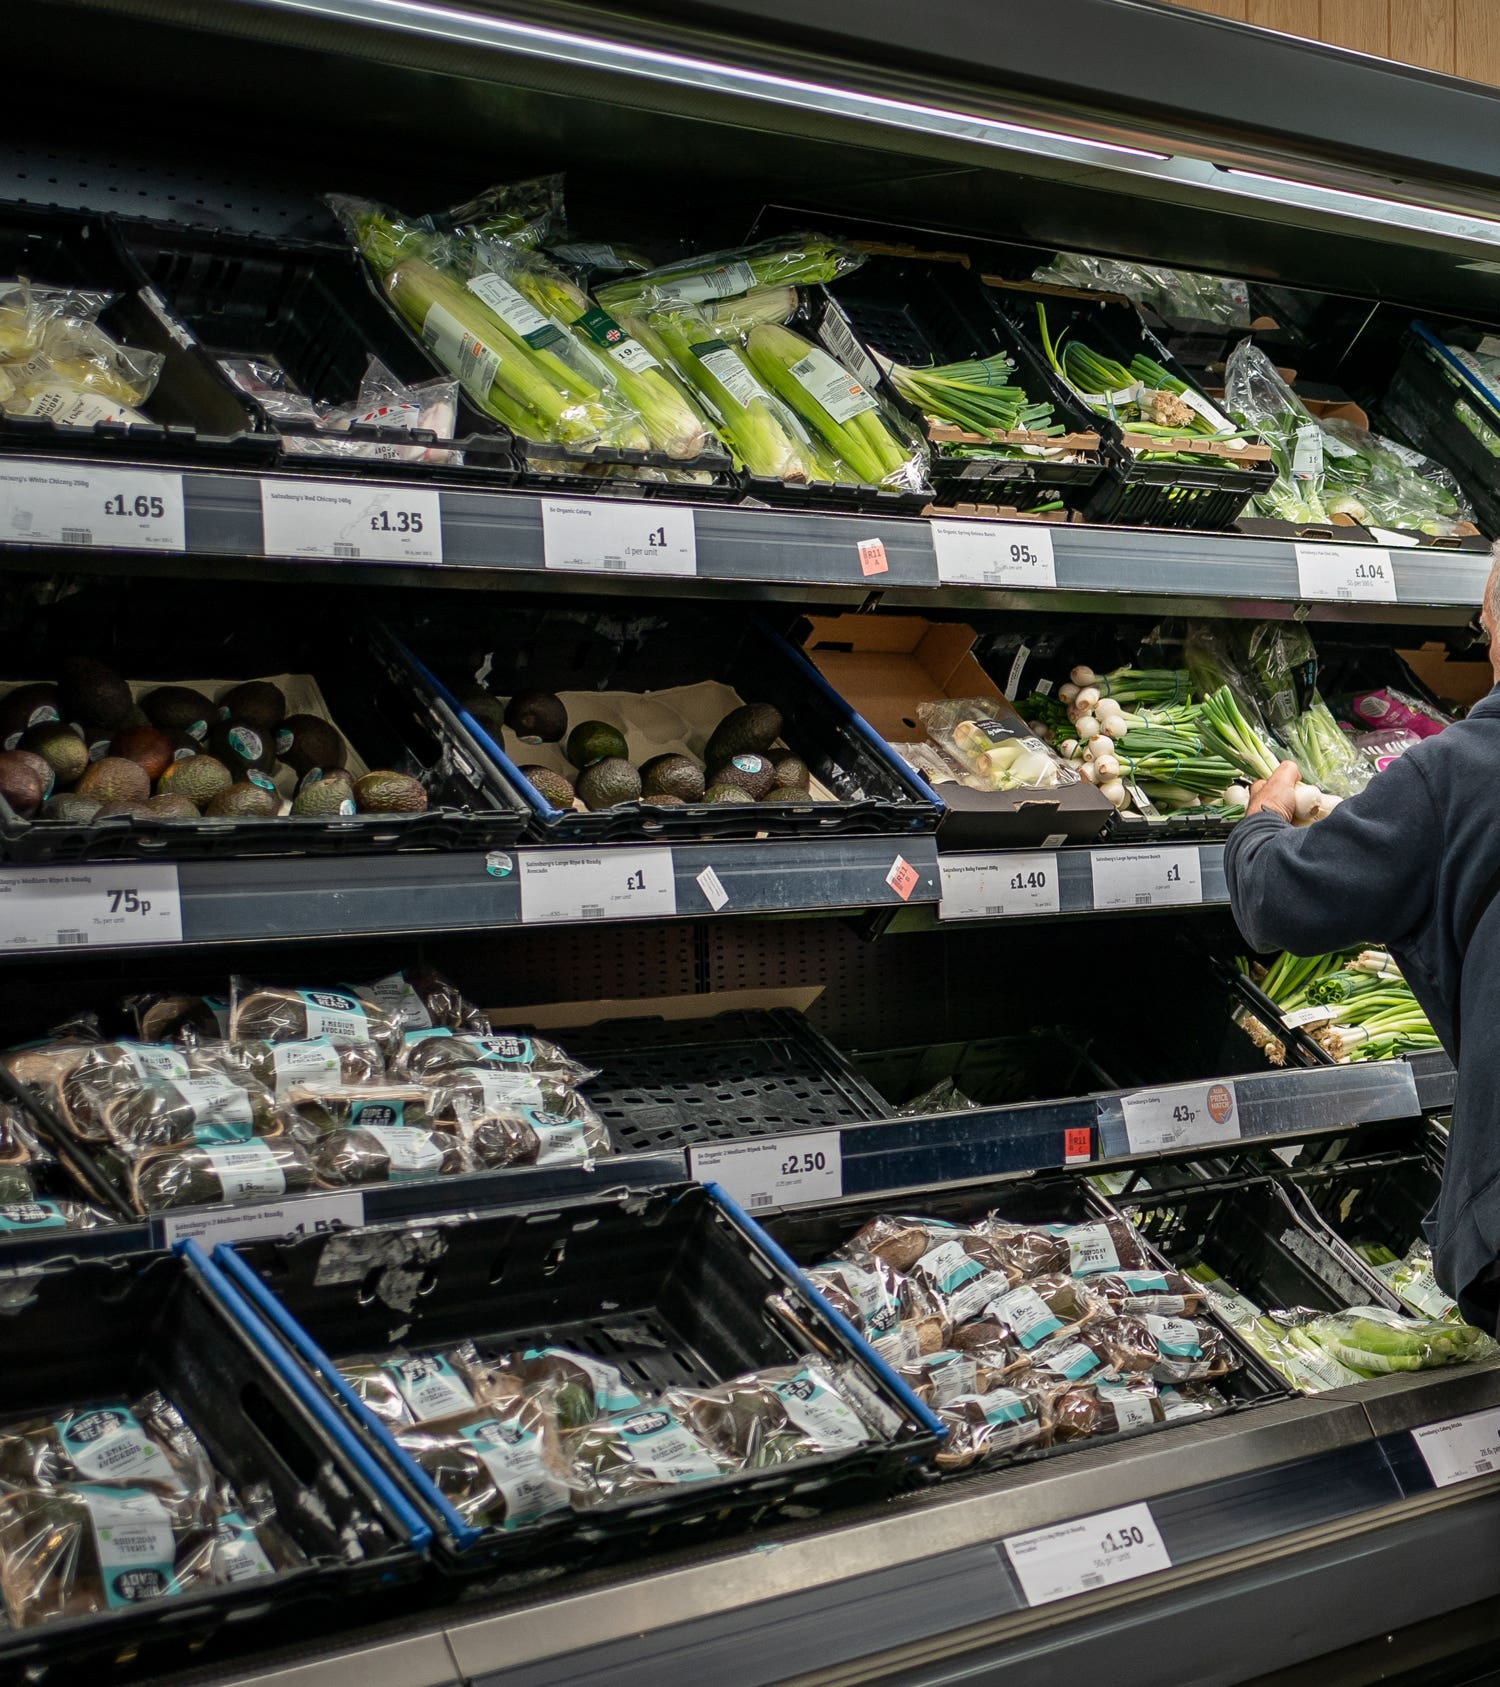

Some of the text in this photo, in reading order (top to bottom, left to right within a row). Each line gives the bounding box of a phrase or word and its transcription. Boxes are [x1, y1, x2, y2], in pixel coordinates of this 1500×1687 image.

[618, 348, 633, 360] 19
[104, 494, 165, 519] £1.65
[556, 507, 575, 516] Organic
[575, 508, 592, 517] Celery
[370, 510, 423, 533] £1.35
[648, 526, 668, 548] £1
[1010, 544, 1038, 567] 95p
[1355, 564, 1385, 579] £1.04
[626, 869, 646, 891] £1
[1010, 871, 1046, 890] £1.40
[1167, 863, 1181, 882] £1
[106, 888, 152, 916] 75p
[317, 998, 350, 1009] READY
[321, 1026, 356, 1036] AVOCADOS
[327, 1020, 355, 1030] MEDIUM
[1172, 1104, 1196, 1123] 43p
[781, 1151, 826, 1176] £2.50
[1101, 1525, 1145, 1554] £1.50
